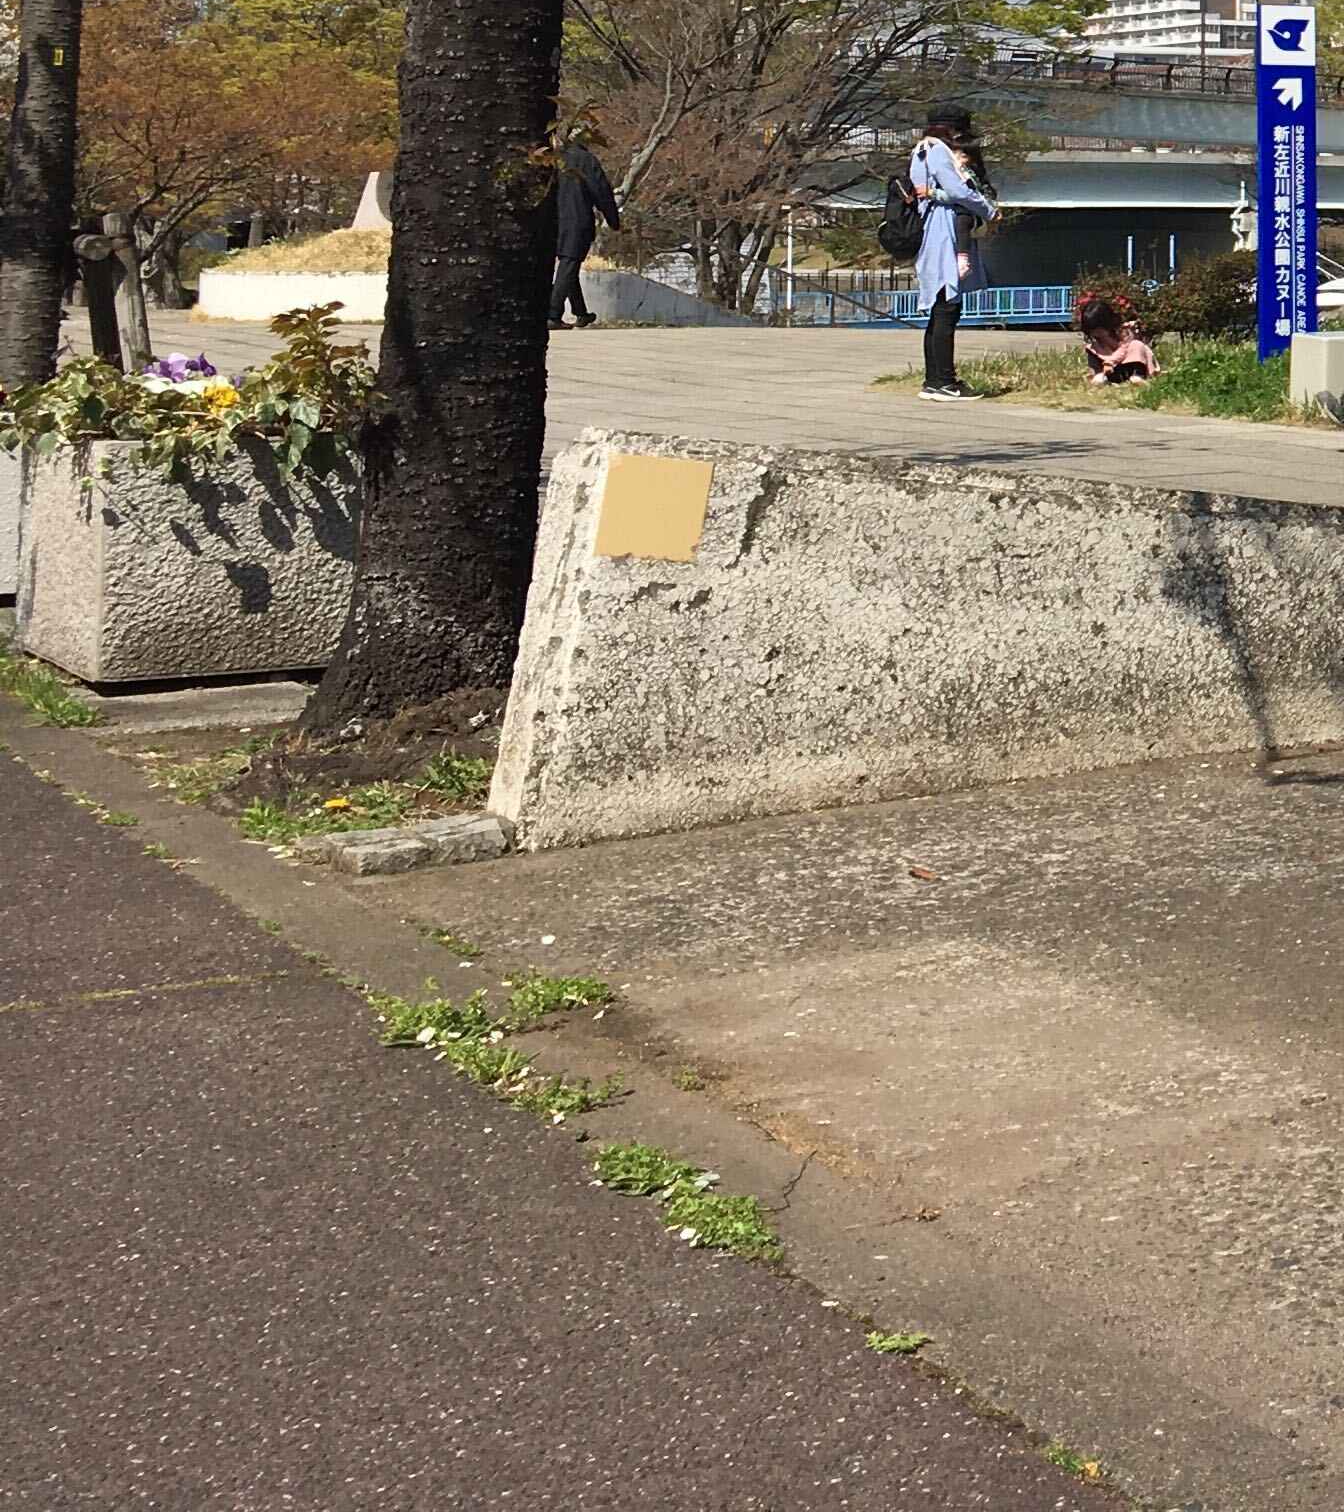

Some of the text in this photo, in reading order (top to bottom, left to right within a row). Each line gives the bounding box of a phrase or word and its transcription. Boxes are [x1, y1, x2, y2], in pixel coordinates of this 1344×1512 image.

[1273, 125, 1291, 336] 新左近川親水公園カヌー場
[1295, 208, 1306, 242] SHINSUI
[1296, 245, 1306, 270] PARK
[1296, 274, 1306, 306] CANOE
